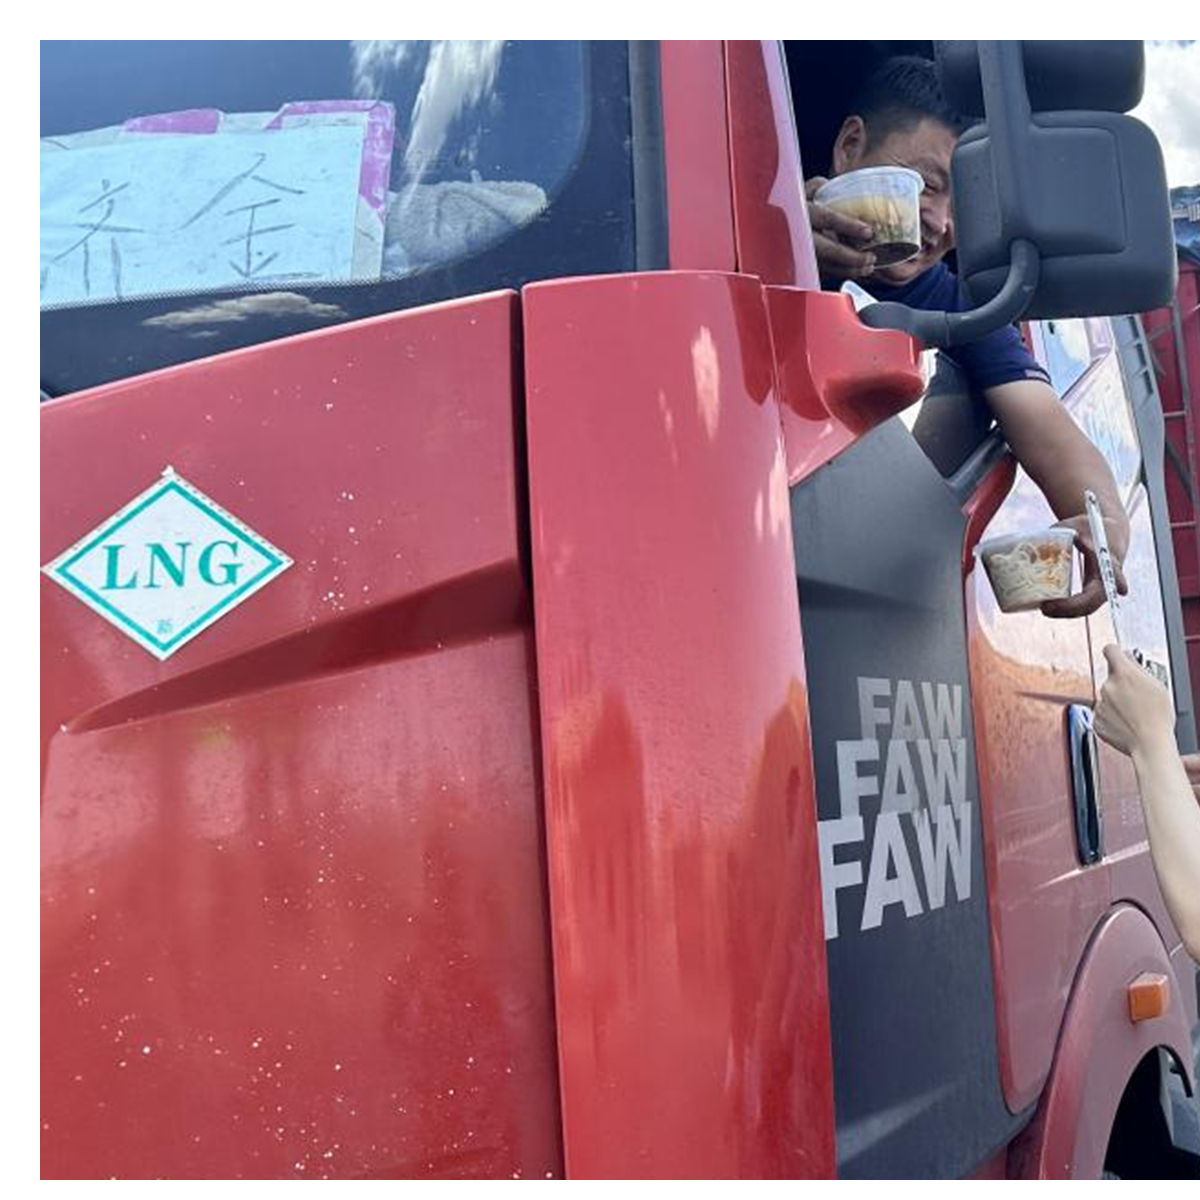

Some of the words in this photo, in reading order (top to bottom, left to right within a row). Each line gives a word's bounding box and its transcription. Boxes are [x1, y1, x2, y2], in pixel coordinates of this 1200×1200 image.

[100, 540, 244, 590] LNG
[857, 676, 962, 748] FAW
[836, 738, 967, 824] FAW
[817, 802, 972, 940] FAW
